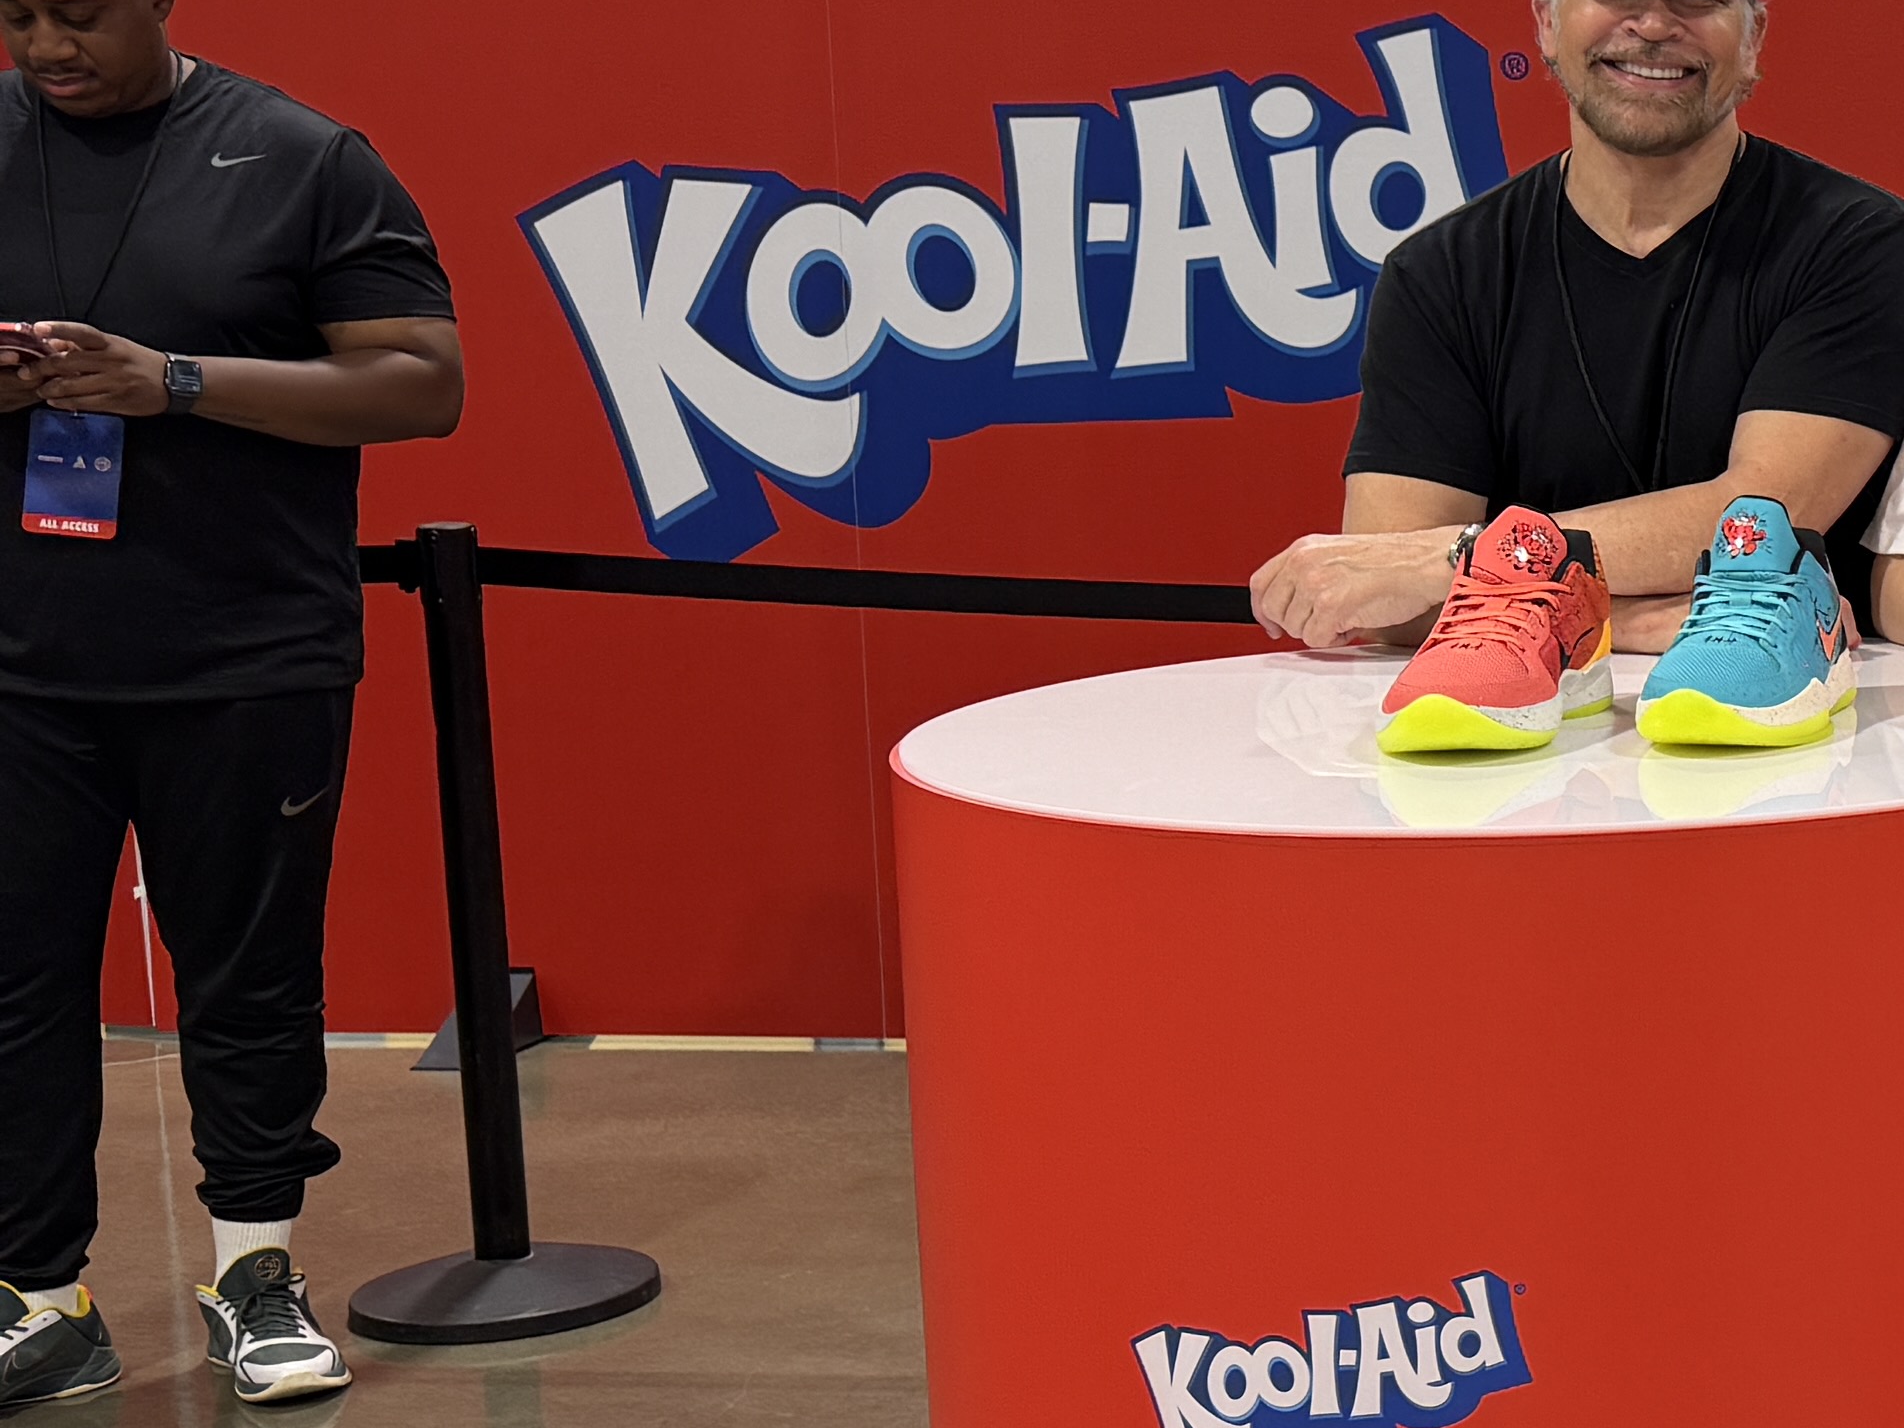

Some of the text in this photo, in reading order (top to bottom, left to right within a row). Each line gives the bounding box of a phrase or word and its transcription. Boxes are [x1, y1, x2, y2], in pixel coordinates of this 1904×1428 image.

[528, 25, 1480, 524] Kool-Aid
[39, 517, 100, 533] ALL ACCESS
